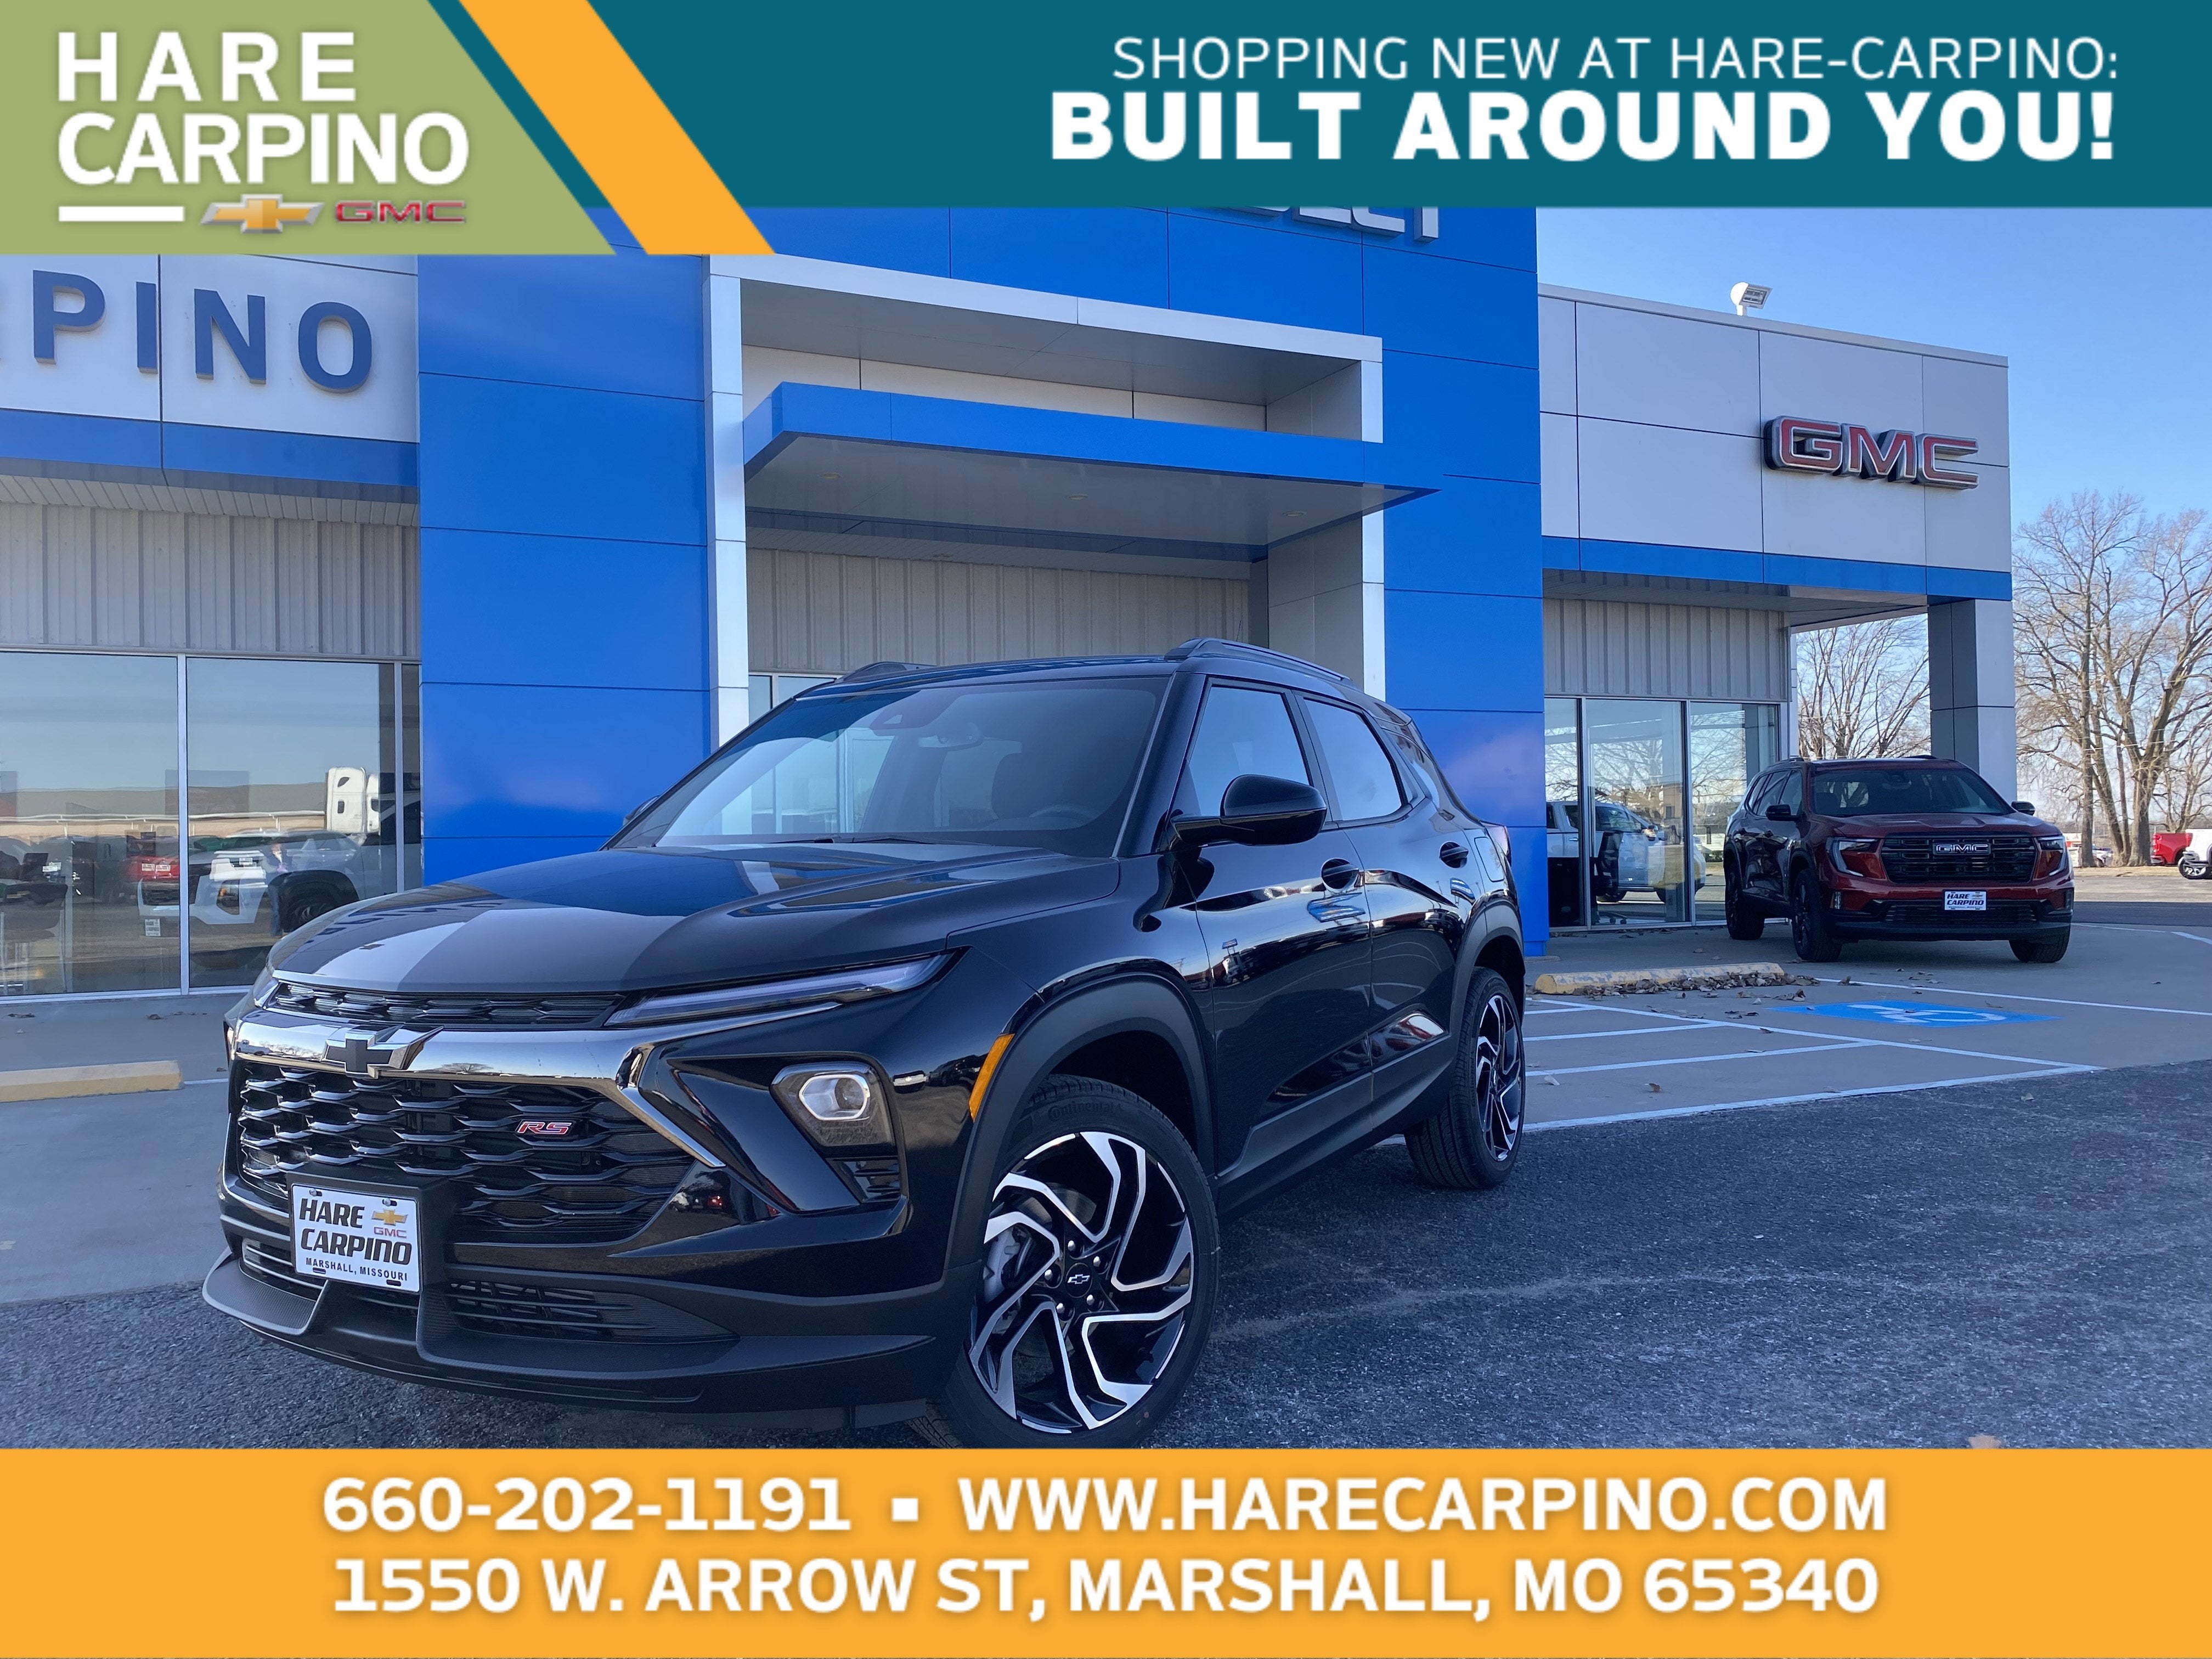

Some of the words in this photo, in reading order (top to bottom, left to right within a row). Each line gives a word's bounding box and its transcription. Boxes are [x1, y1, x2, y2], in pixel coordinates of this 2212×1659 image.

[1764, 415, 1979, 490] GMC
[1936, 844, 1989, 854] GMC
[517, 1121, 572, 1135] RS
[299, 1198, 365, 1229] HARE
[373, 1226, 407, 1239] GMC
[301, 1228, 412, 1266] CARPINO
[306, 1257, 357, 1276] MARSHALL,
[359, 1266, 408, 1282] MISSOURI
